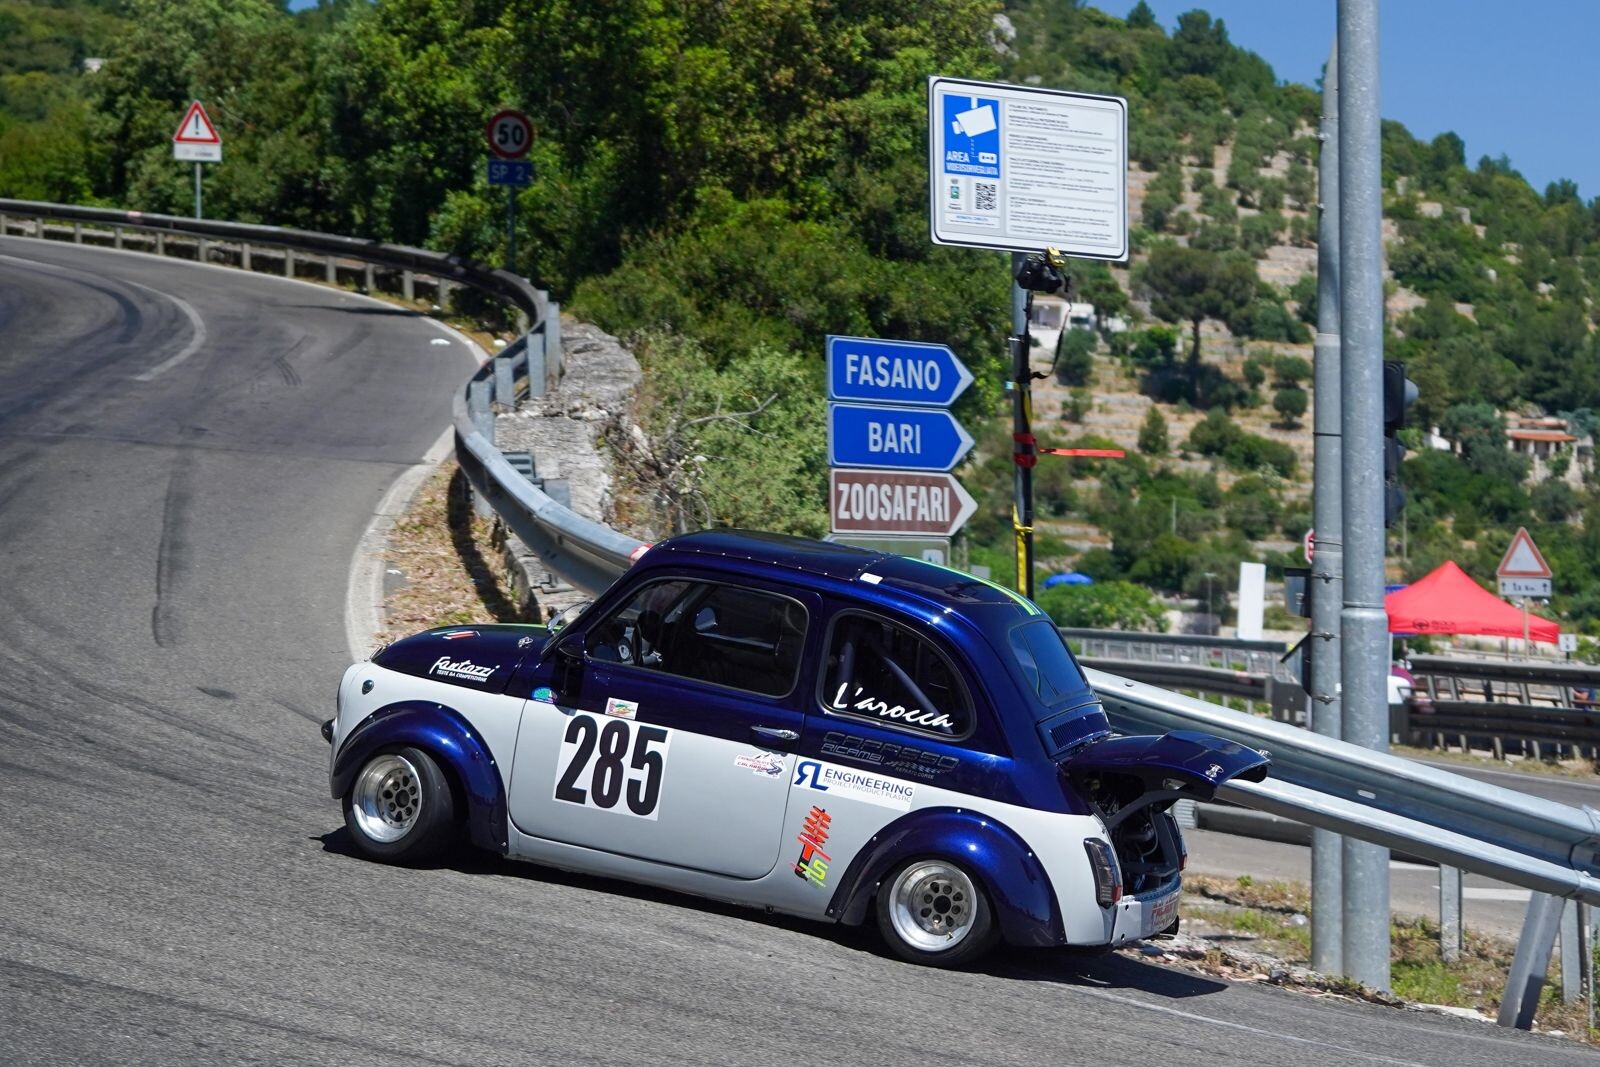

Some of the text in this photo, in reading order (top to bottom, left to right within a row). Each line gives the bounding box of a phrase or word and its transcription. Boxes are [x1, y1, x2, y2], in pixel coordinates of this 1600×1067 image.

[498, 123, 525, 146] 50
[946, 150, 970, 163] AREA
[491, 164, 509, 180] SP
[845, 354, 941, 391] FASANO
[868, 422, 921, 454] BARI
[837, 482, 951, 522] ZOOSAFARI
[429, 656, 500, 677] Fantozzi
[555, 714, 669, 817] 285
[820, 743, 885, 763] RICAMBI
[823, 778, 911, 803] PROJECT PRODUCT PLASTIC
[824, 768, 914, 797] ENGINEERING
